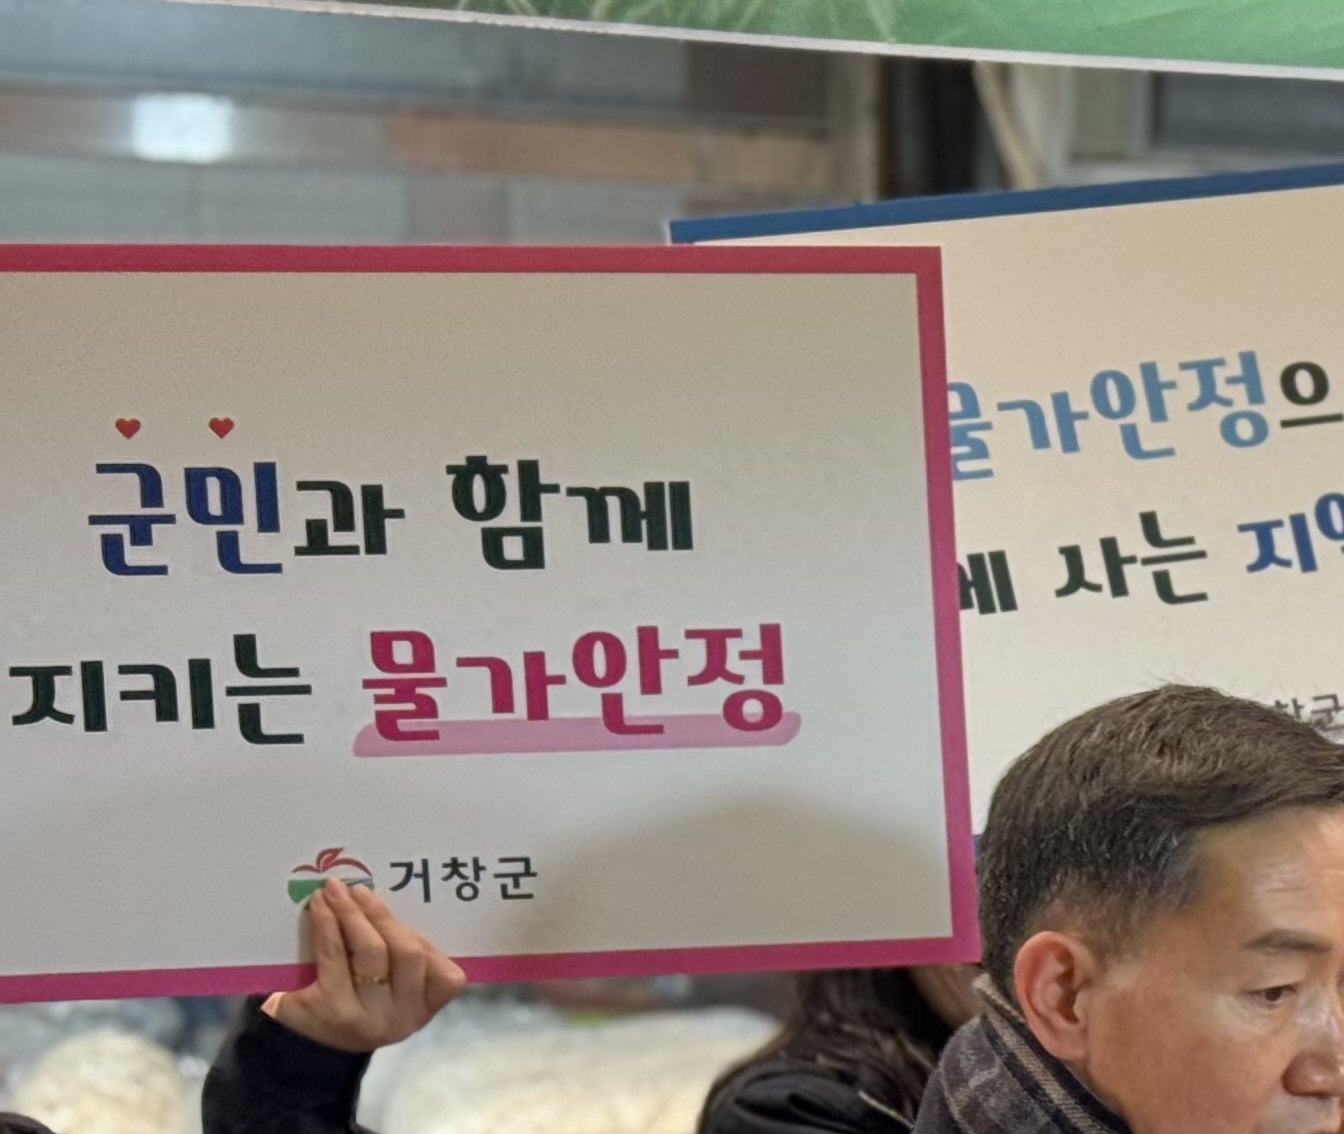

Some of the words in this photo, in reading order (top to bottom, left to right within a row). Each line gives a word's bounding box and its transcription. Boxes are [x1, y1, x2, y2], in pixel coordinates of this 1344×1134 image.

[88, 461, 405, 577] 군민과
[446, 455, 694, 570] 함께
[1054, 511, 1209, 606] 사는
[9, 634, 312, 745] 지키는
[361, 623, 786, 741] 물가안정
[389, 856, 539, 903] 거창군
